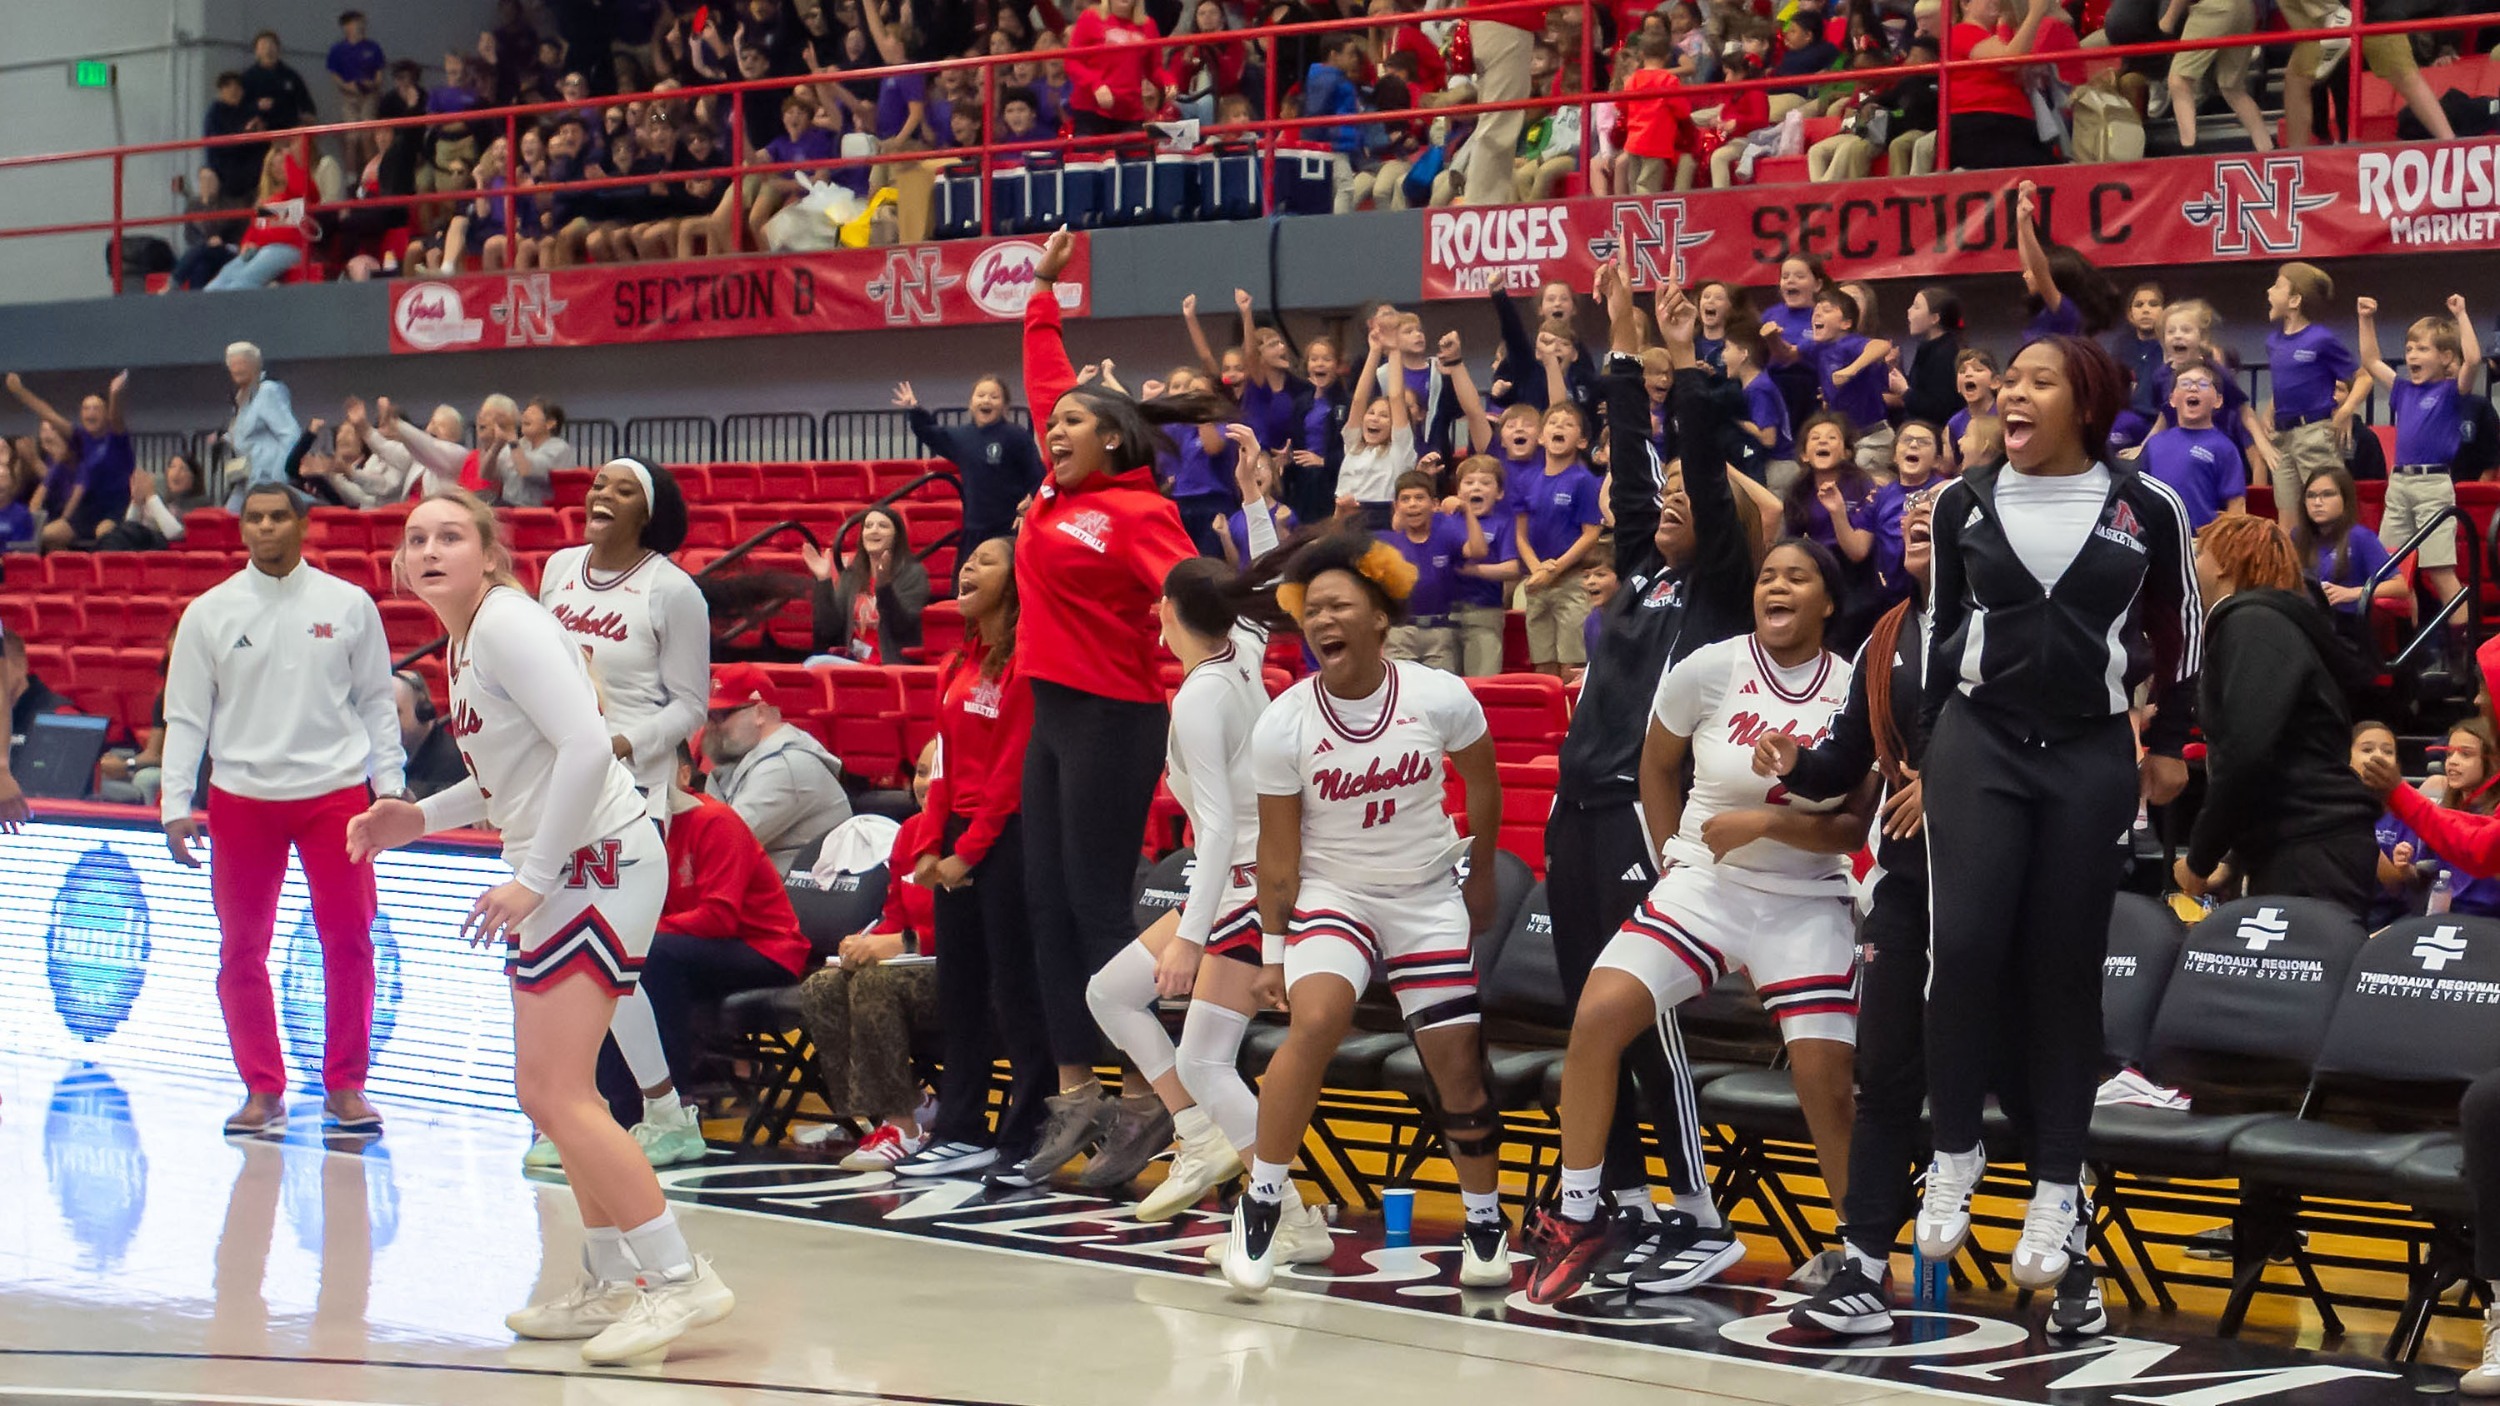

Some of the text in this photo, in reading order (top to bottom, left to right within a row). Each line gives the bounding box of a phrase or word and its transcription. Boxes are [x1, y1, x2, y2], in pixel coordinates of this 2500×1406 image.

[2213, 156, 2303, 256] N
[2358, 144, 2500, 220] ROUS
[1430, 205, 1568, 270] ROUSES
[1612, 198, 1686, 288] N
[1752, 181, 2133, 264] SECTION C
[2390, 212, 2500, 246] MARKET
[506, 273, 554, 346] N
[614, 270, 774, 327] SECTION
[886, 247, 942, 325] N
[1312, 749, 1433, 802] Nicholls
[564, 839, 622, 889] N
[1525, 922, 1553, 935] HEA
[2104, 955, 2138, 967] IONAL
[2106, 966, 2137, 977] TEM
[2184, 961, 2323, 982] HEALTH SYSTEM
[2187, 950, 2324, 972] THIBODAUX REGIONAL
[2360, 971, 2500, 994] THIBODAUX REGIONAL
[2356, 981, 2500, 1004] HEALTH SYSTEM
